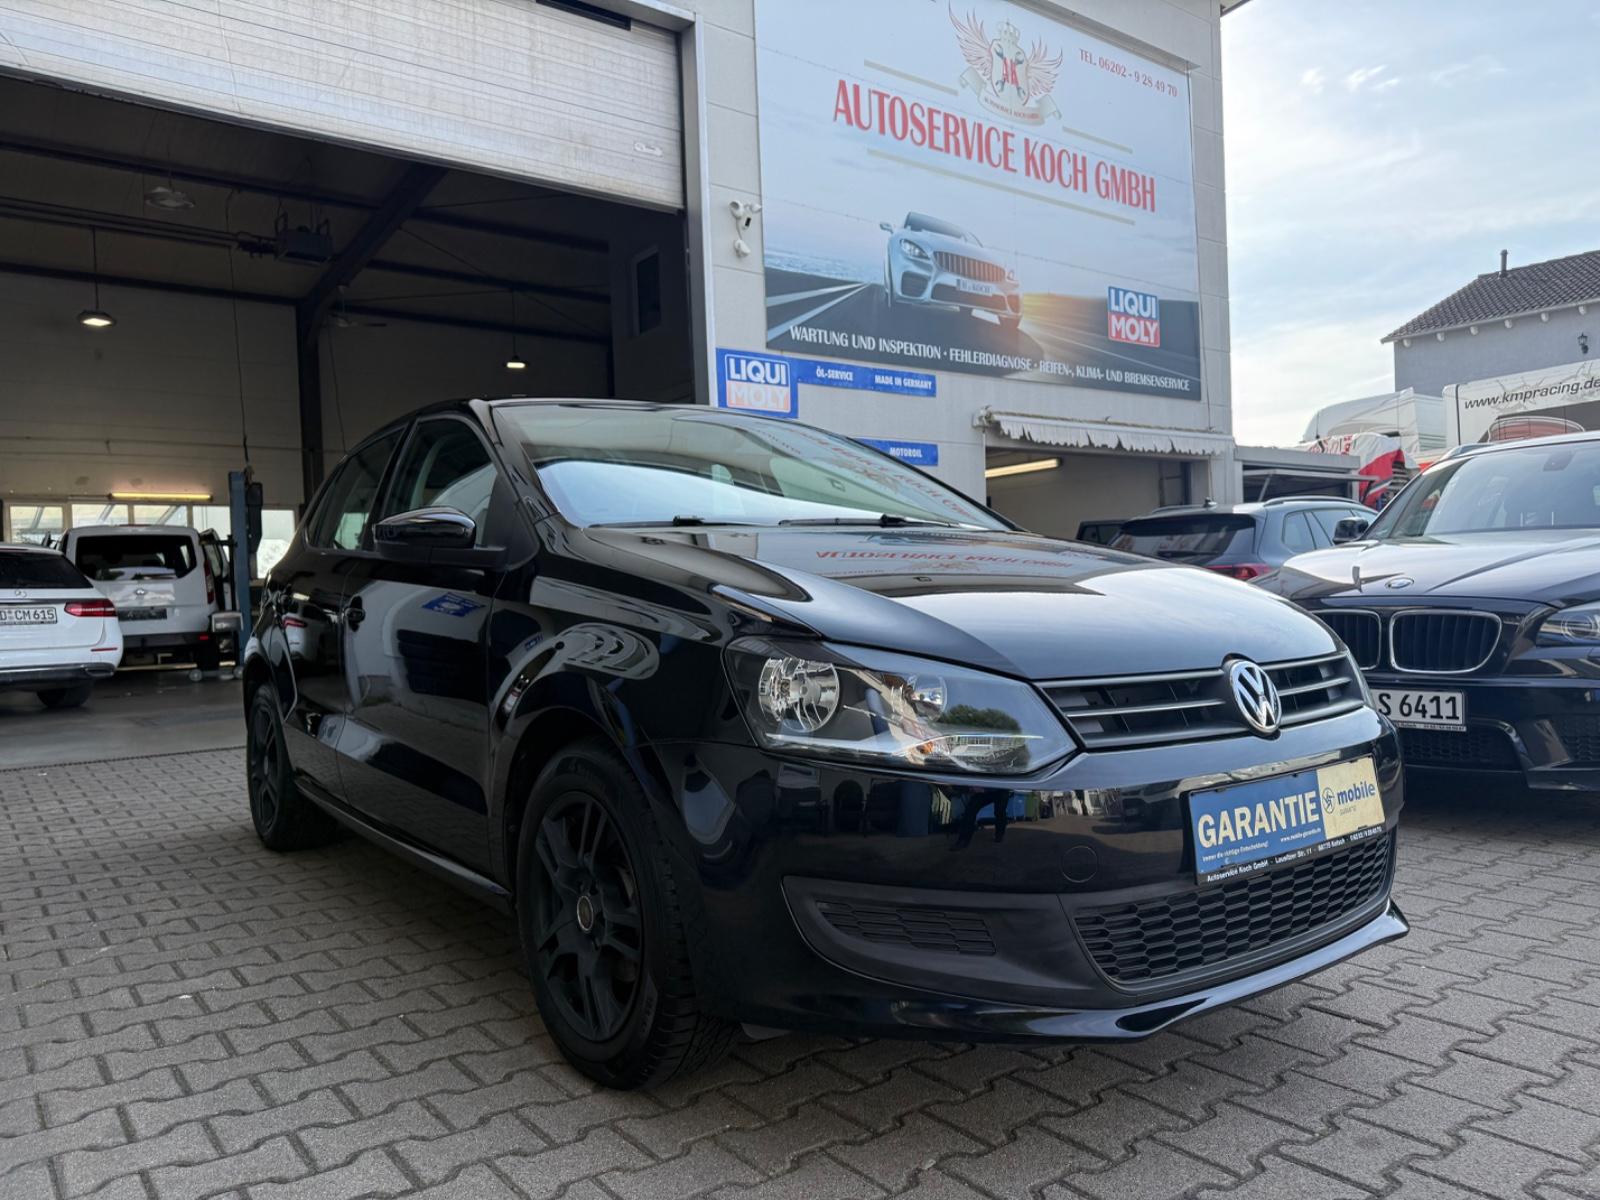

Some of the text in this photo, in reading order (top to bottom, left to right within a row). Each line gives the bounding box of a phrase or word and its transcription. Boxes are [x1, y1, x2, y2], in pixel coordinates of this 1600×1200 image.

[1079, 48, 1096, 65] TEL.
[1099, 57, 1126, 77] 06202
[1142, 73, 1153, 88] 28
[1155, 80, 1165, 93] 49
[1167, 84, 1178, 97] 70
[833, 79, 1155, 212] AUTOSERVICE KOCH GMBH
[1110, 288, 1157, 318] LIQUI
[1111, 316, 1160, 343] MOLY
[729, 357, 787, 385] LIQUI
[790, 325, 849, 347] WARTUNG
[851, 334, 876, 350] UND
[879, 338, 941, 360] INSPEKTION
[949, 348, 1033, 371] FEHLERDIAGNOSE
[1076, 365, 1104, 380] KLIMA-
[1105, 369, 1123, 383] UND
[1124, 371, 1191, 391] BREMSENSERVICE
[816, 365, 854, 381] ÖL-SERVICE
[874, 374, 894, 386] MADE
[902, 378, 932, 390] GERMANY
[730, 384, 789, 410] MOLY
[1464, 376, 1600, 409] www.kmpracing.de
[889, 446, 922, 458] MOTOROIL
[15, 609, 31, 620] CM
[33, 609, 54, 620] 615
[1399, 694, 1460, 720] 6411
[1337, 780, 1376, 805] mobile
[1198, 790, 1319, 848] GARANTIE
[1207, 868, 1238, 882] Autoservice
[1239, 863, 1252, 873] Koch
[1253, 859, 1268, 870] GmbH
